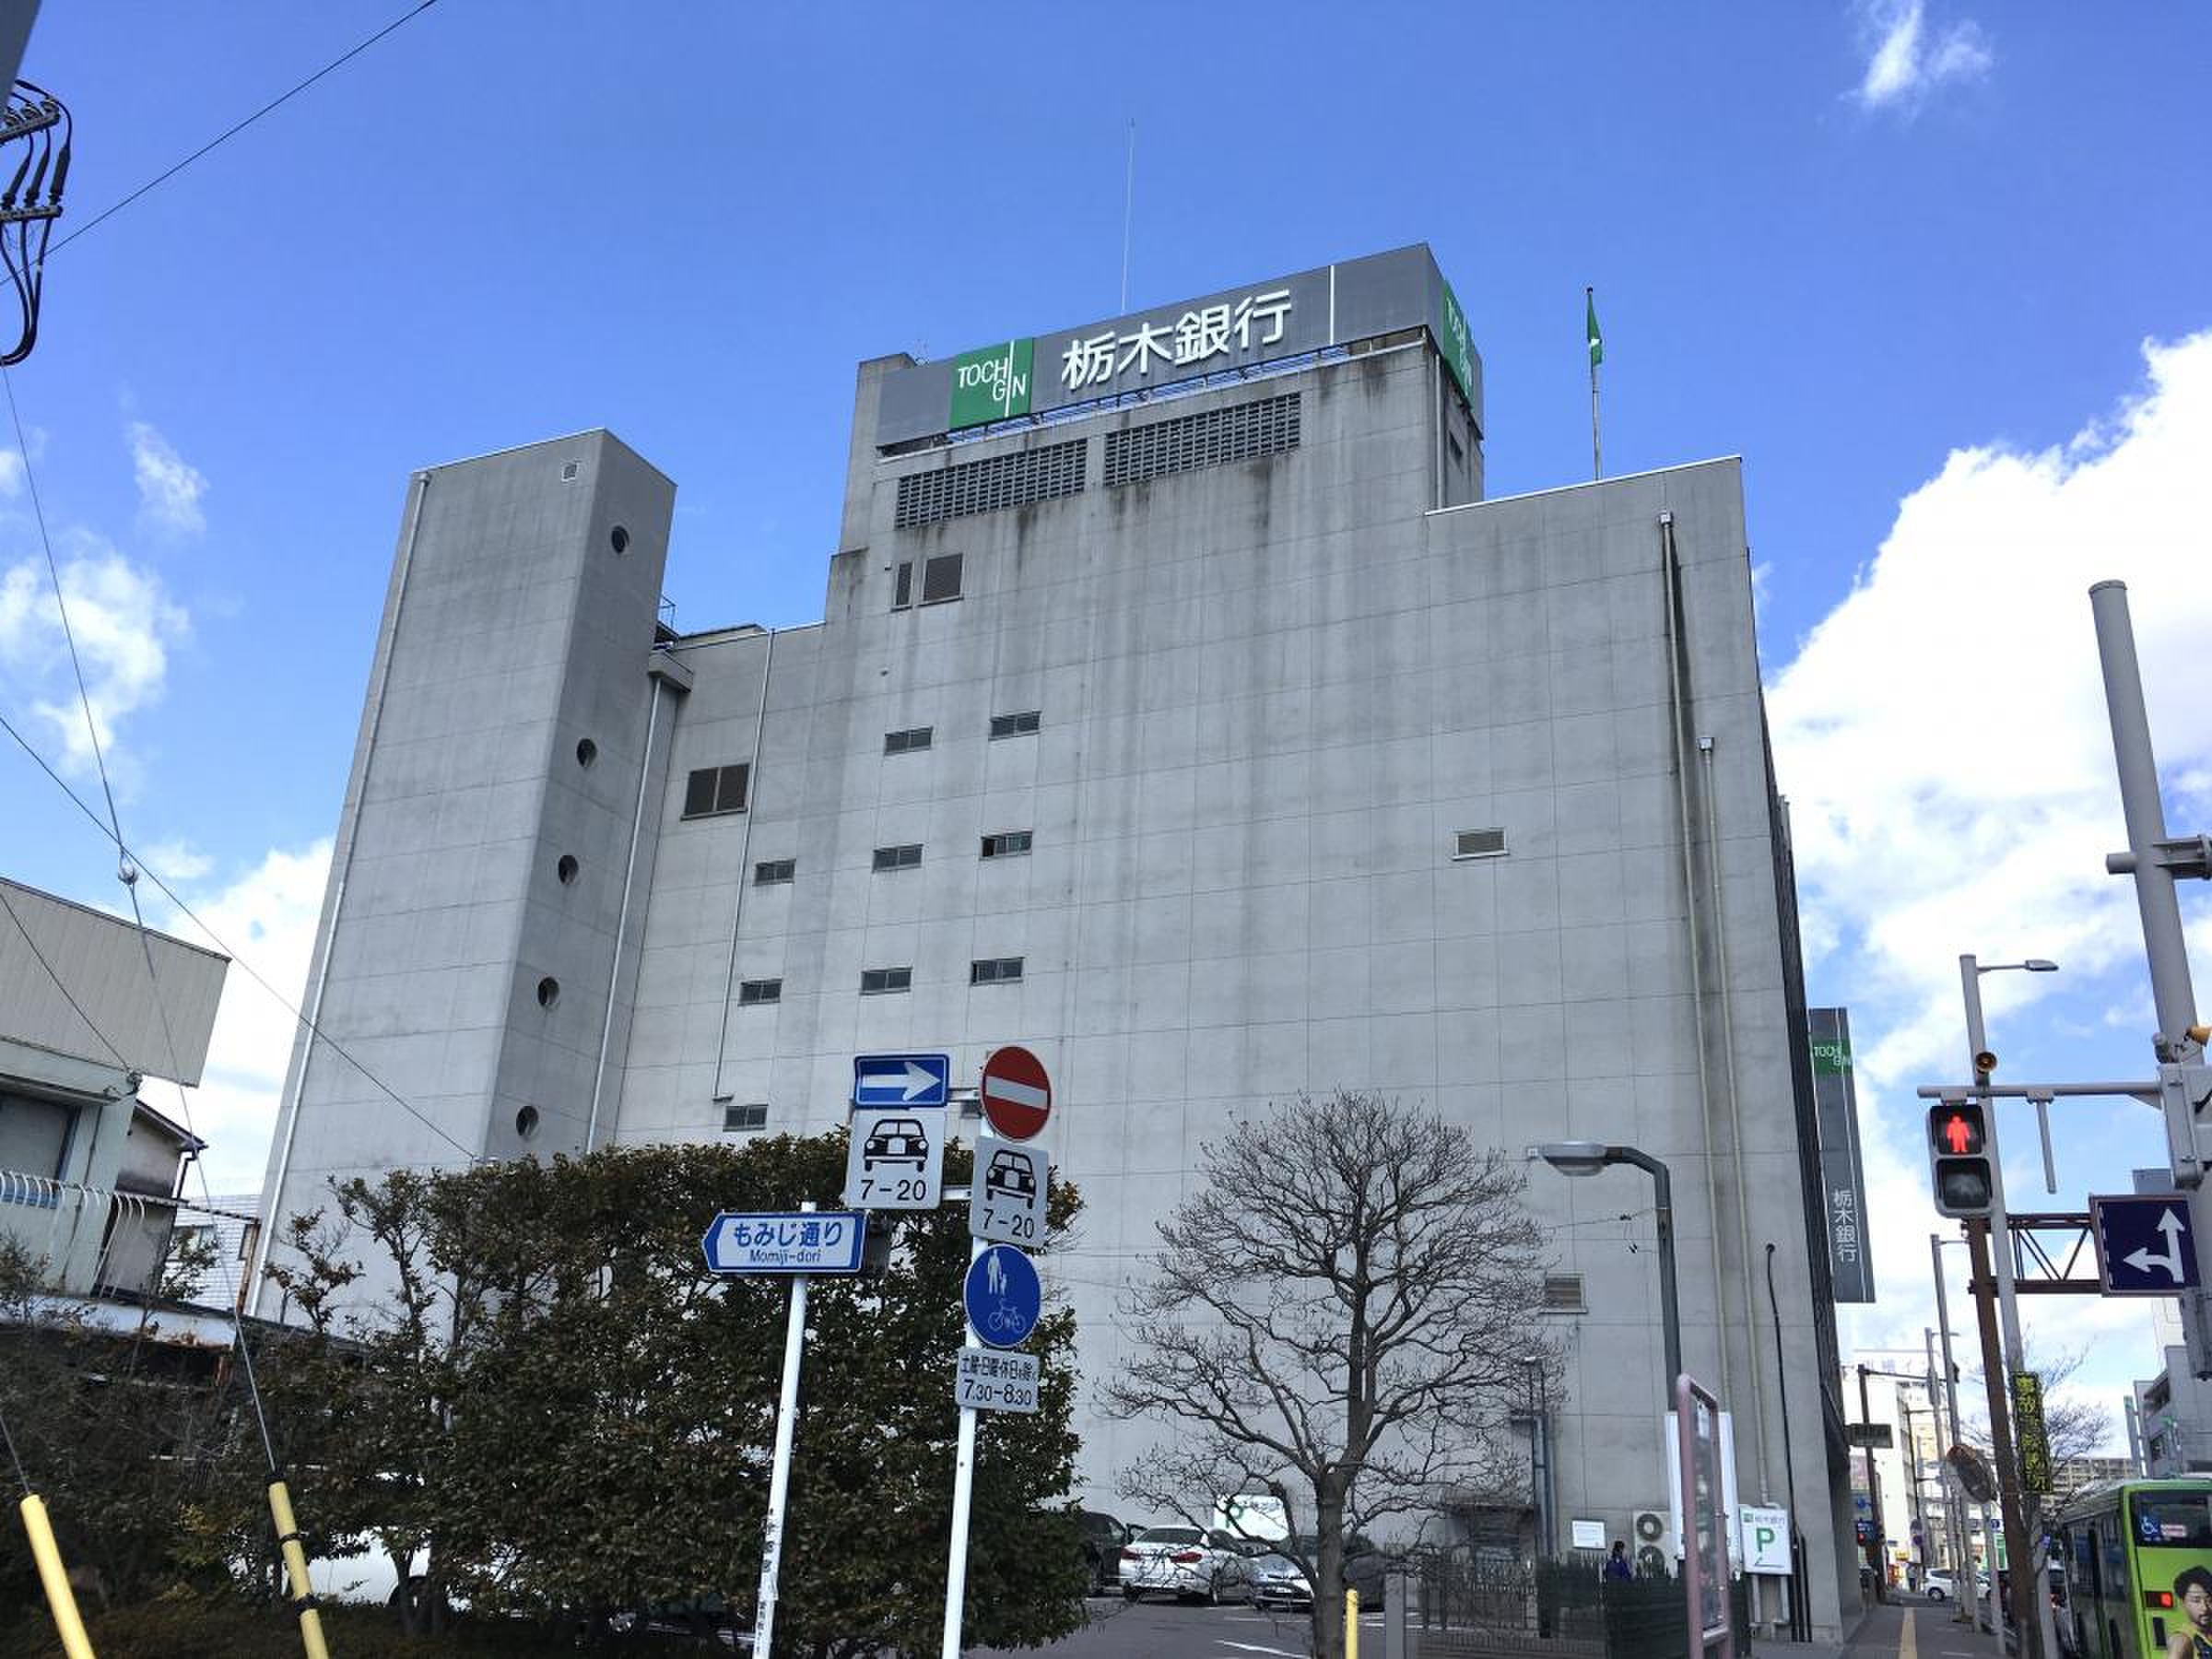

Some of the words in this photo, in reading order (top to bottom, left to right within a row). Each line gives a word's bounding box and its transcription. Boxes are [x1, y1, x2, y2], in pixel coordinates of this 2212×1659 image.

[1062, 288, 1291, 390] 栃木銀行
[734, 1221, 842, 1247] もみじ通り
[749, 1249, 822, 1265] Momiji-dori
[1756, 1527, 1775, 1552] P
